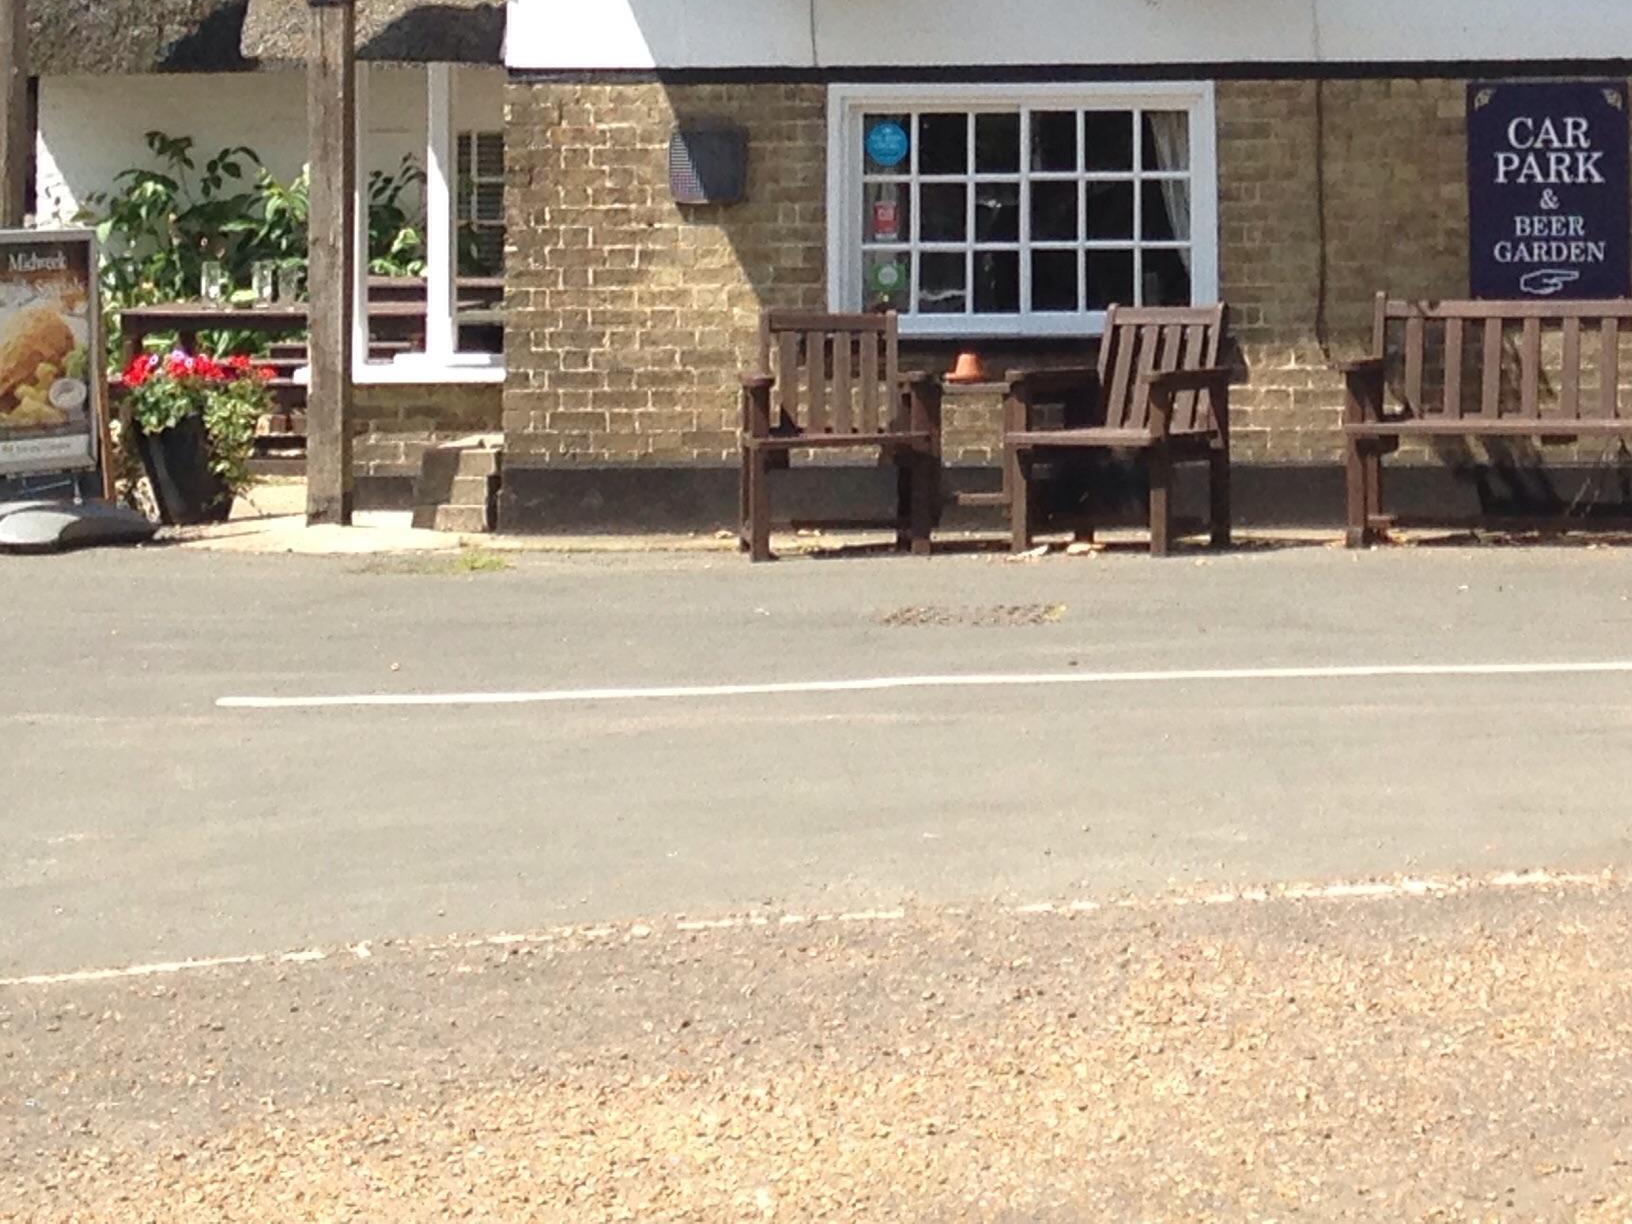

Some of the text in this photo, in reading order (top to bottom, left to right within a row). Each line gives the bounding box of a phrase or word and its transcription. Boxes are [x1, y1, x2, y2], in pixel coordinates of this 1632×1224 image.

[1507, 116, 1591, 149] CAR
[1493, 151, 1606, 184] PARK
[1539, 188, 1560, 209] &
[1514, 216, 1585, 237] BEER
[1493, 240, 1607, 263] GARDEN
